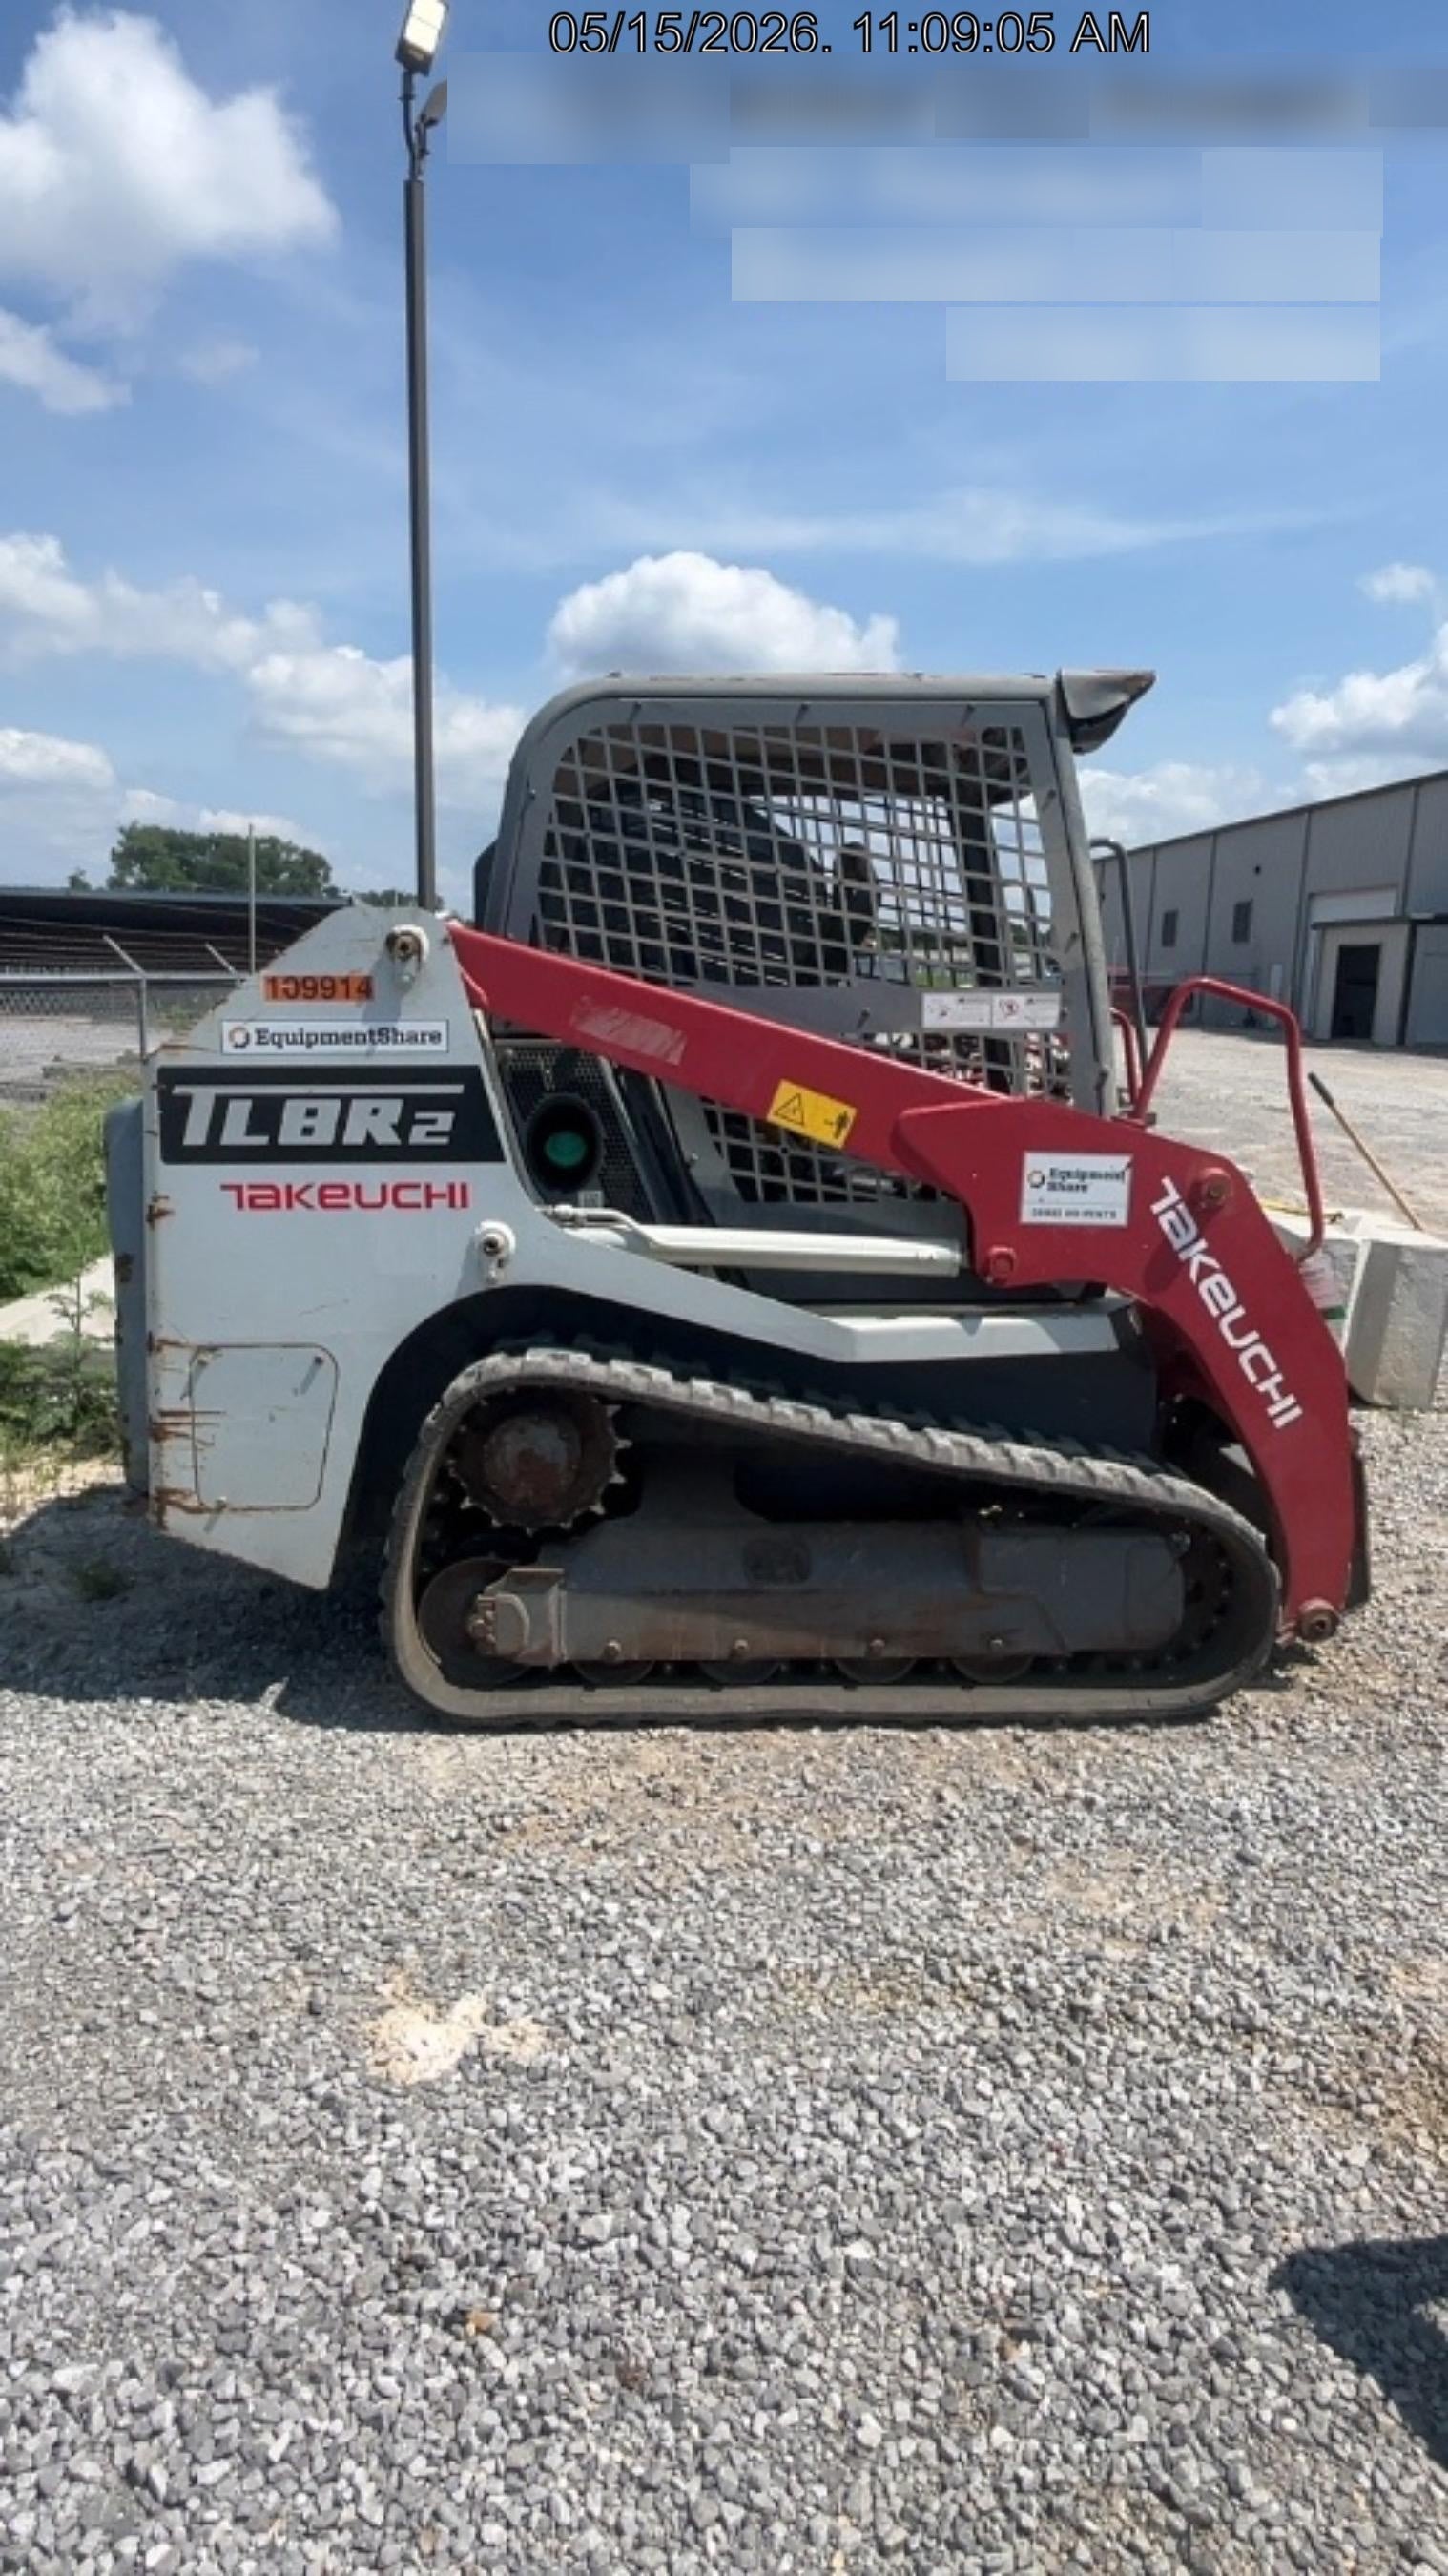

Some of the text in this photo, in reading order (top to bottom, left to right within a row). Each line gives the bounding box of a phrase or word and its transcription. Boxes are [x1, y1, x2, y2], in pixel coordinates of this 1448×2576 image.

[266, 976, 373, 1000] 109914
[255, 1027, 442, 1049] EquipmentShare
[172, 1084, 465, 1145] TL8R2
